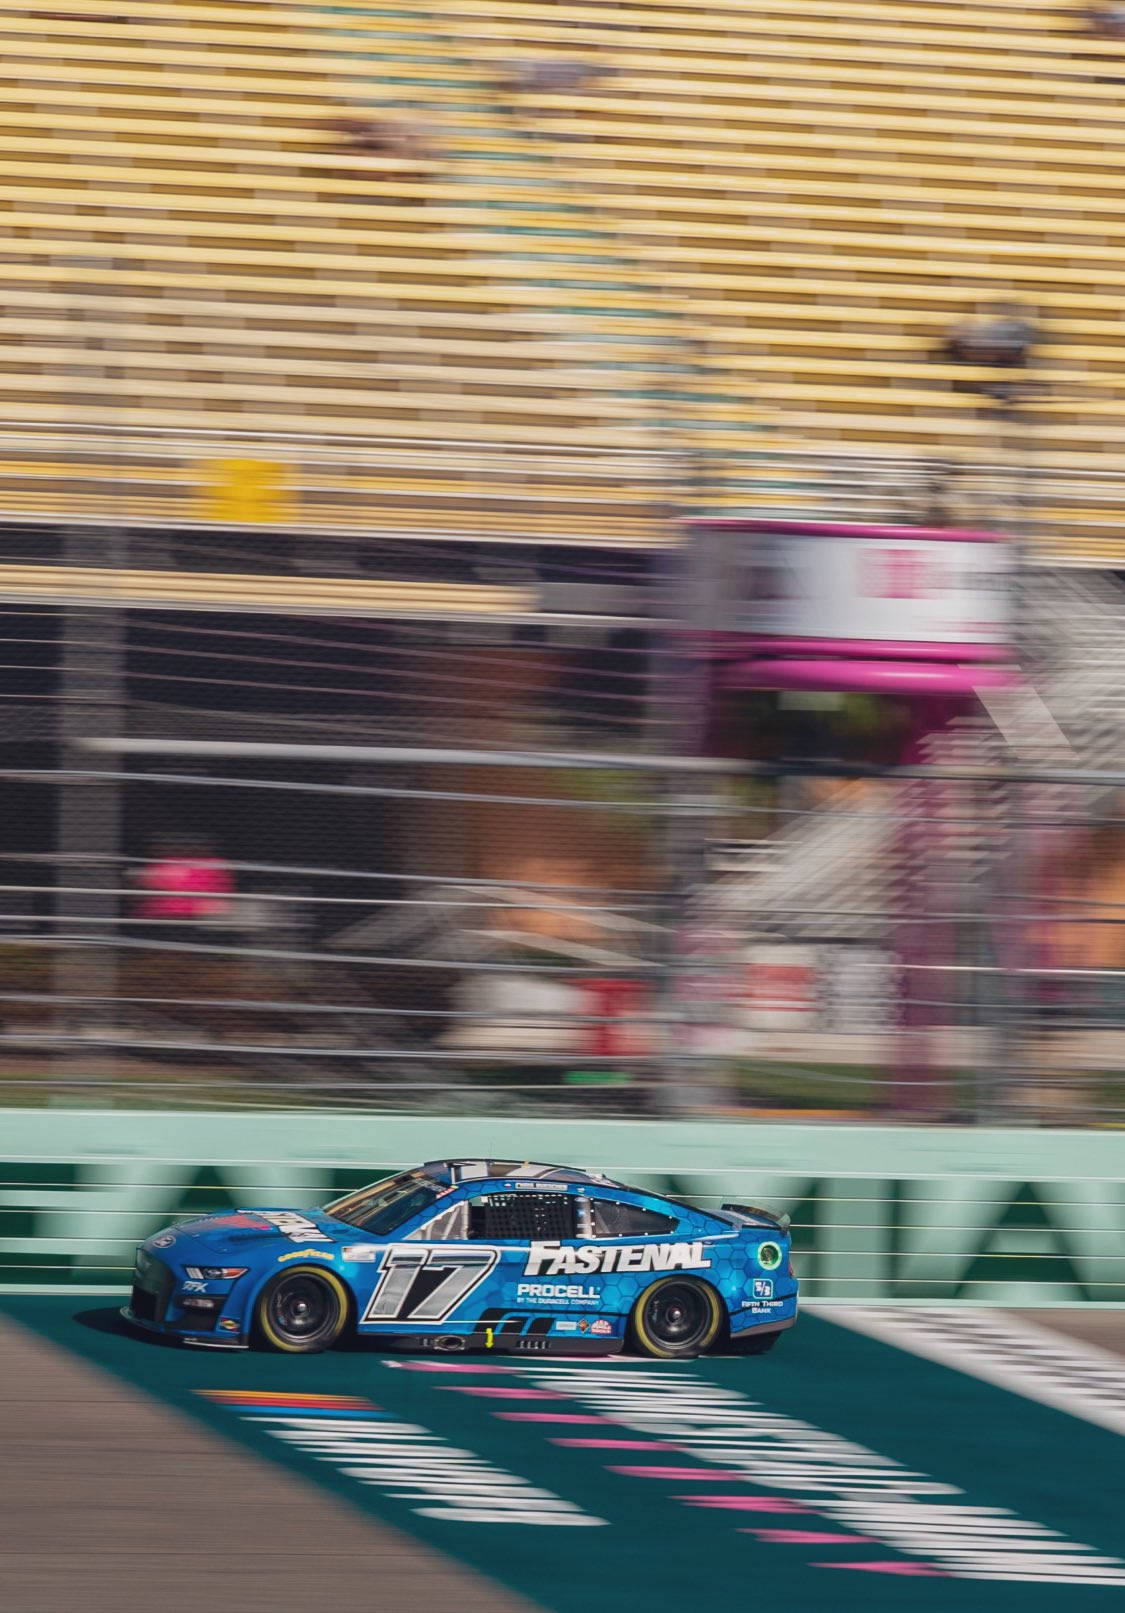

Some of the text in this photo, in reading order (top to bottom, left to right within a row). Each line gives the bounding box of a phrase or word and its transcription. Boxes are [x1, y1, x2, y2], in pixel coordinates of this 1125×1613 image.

[523, 1240, 711, 1276] FASTENAL
[361, 1244, 500, 1324] 17
[517, 1283, 600, 1299] PROCELL
